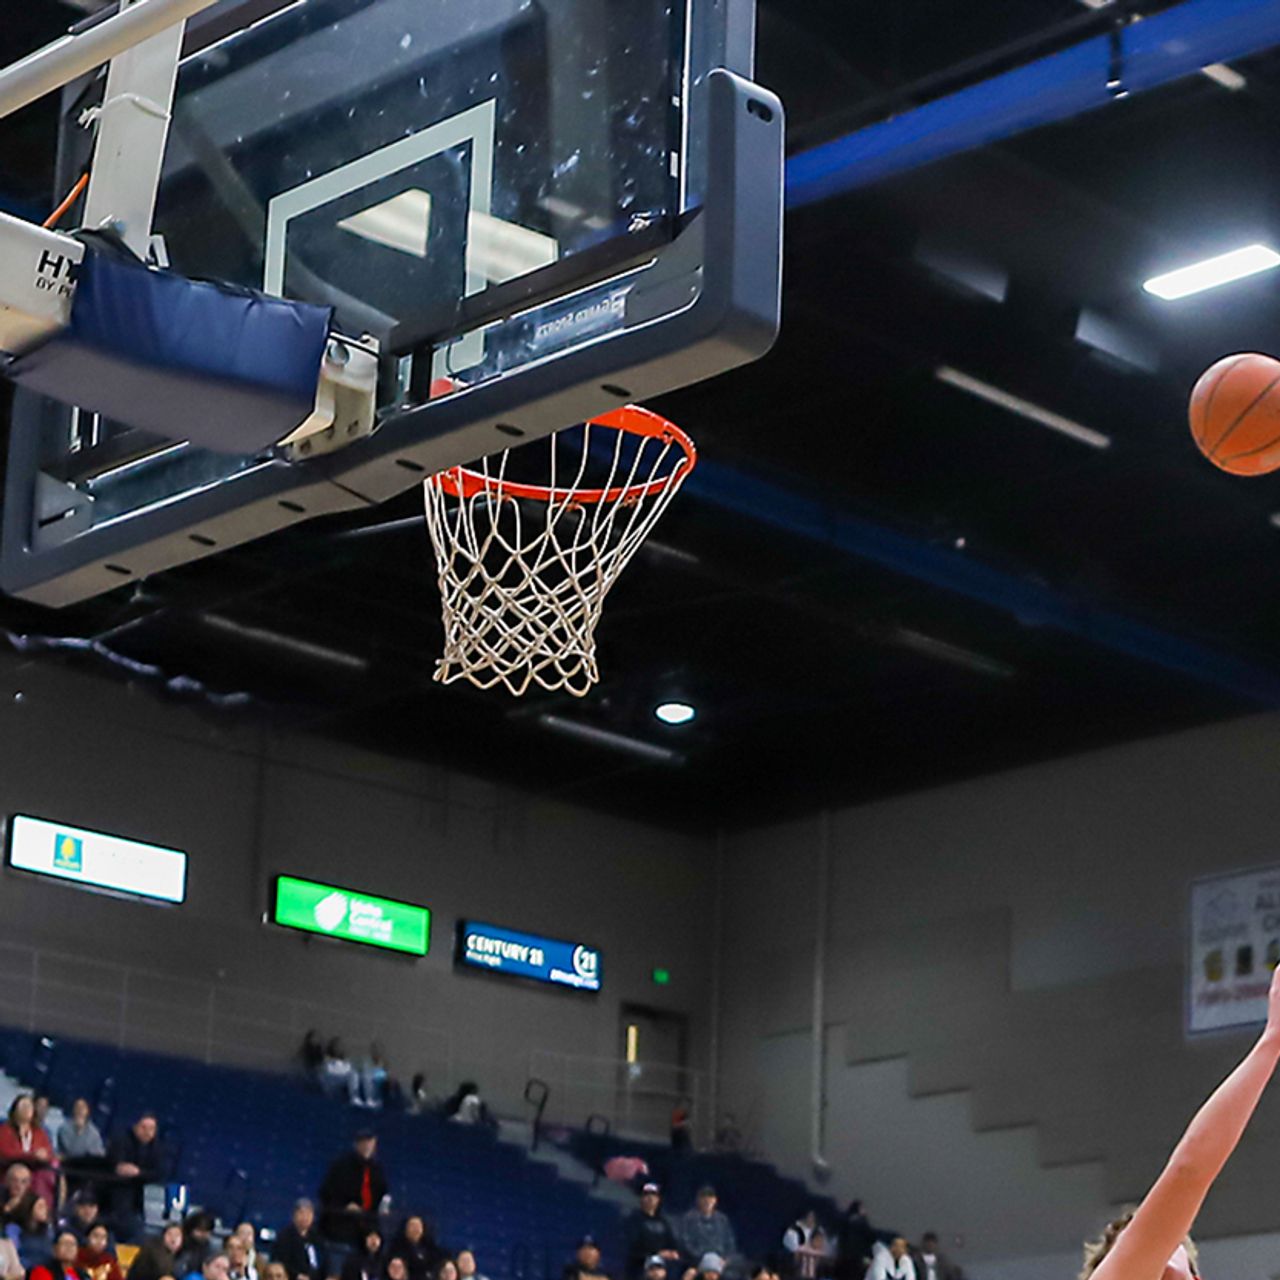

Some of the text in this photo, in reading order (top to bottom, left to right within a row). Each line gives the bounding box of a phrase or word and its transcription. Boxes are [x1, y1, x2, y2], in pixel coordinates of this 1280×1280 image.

[466, 933, 545, 967] CENTURY 21
[172, 1184, 186, 1210] J
